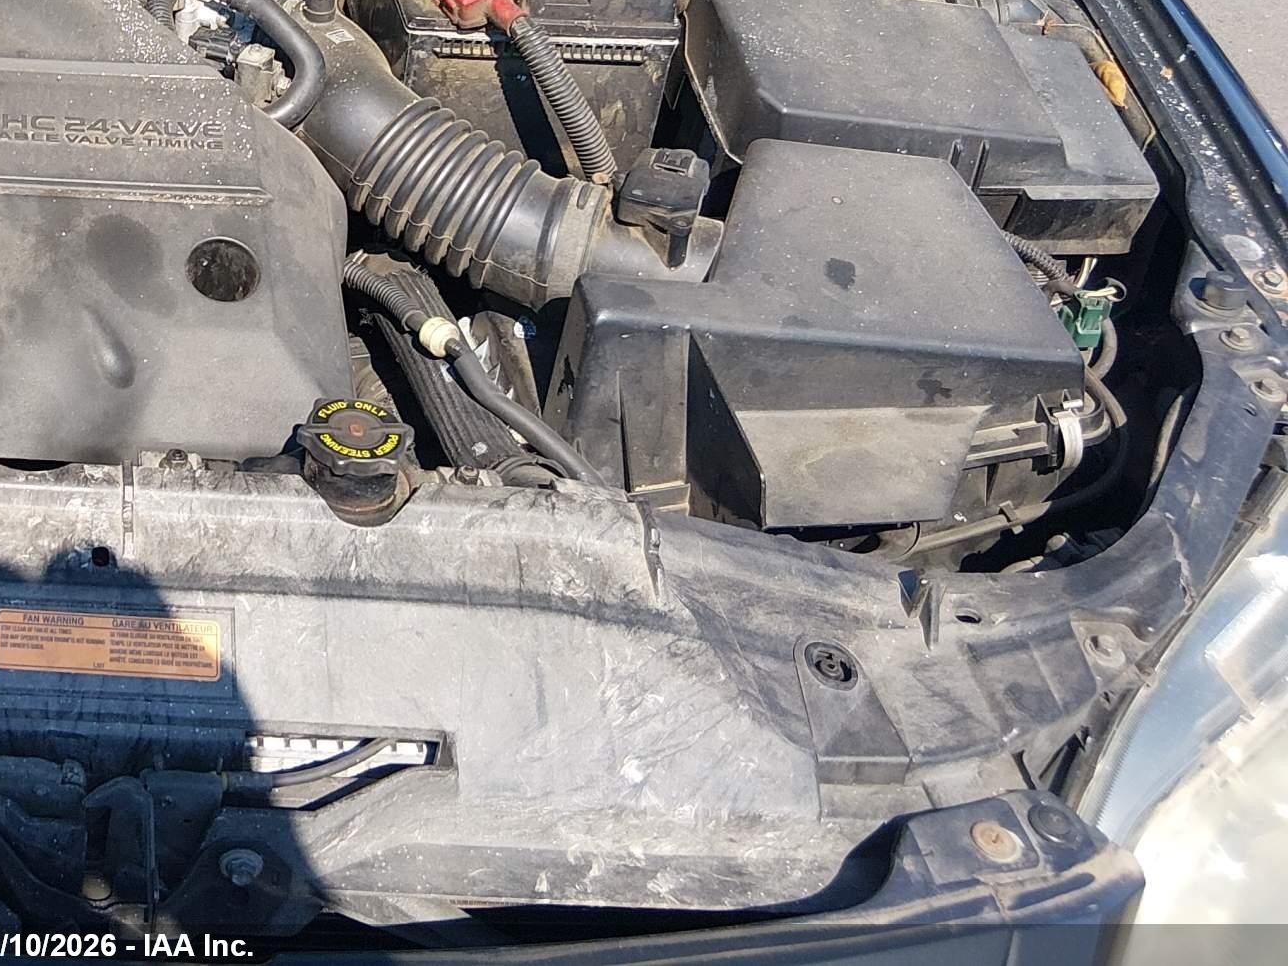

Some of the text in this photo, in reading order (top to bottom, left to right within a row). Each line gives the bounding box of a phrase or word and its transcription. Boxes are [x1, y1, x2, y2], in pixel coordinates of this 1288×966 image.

[63, 116, 224, 138] 24-VALVE
[64, 134, 136, 147] VALVE
[142, 137, 224, 150] TIMING
[317, 401, 399, 458] POWER STEERING FLUID ONLY
[23, 613, 85, 626] FAN WARNING
[153, 621, 213, 634] VENTILATEUR
